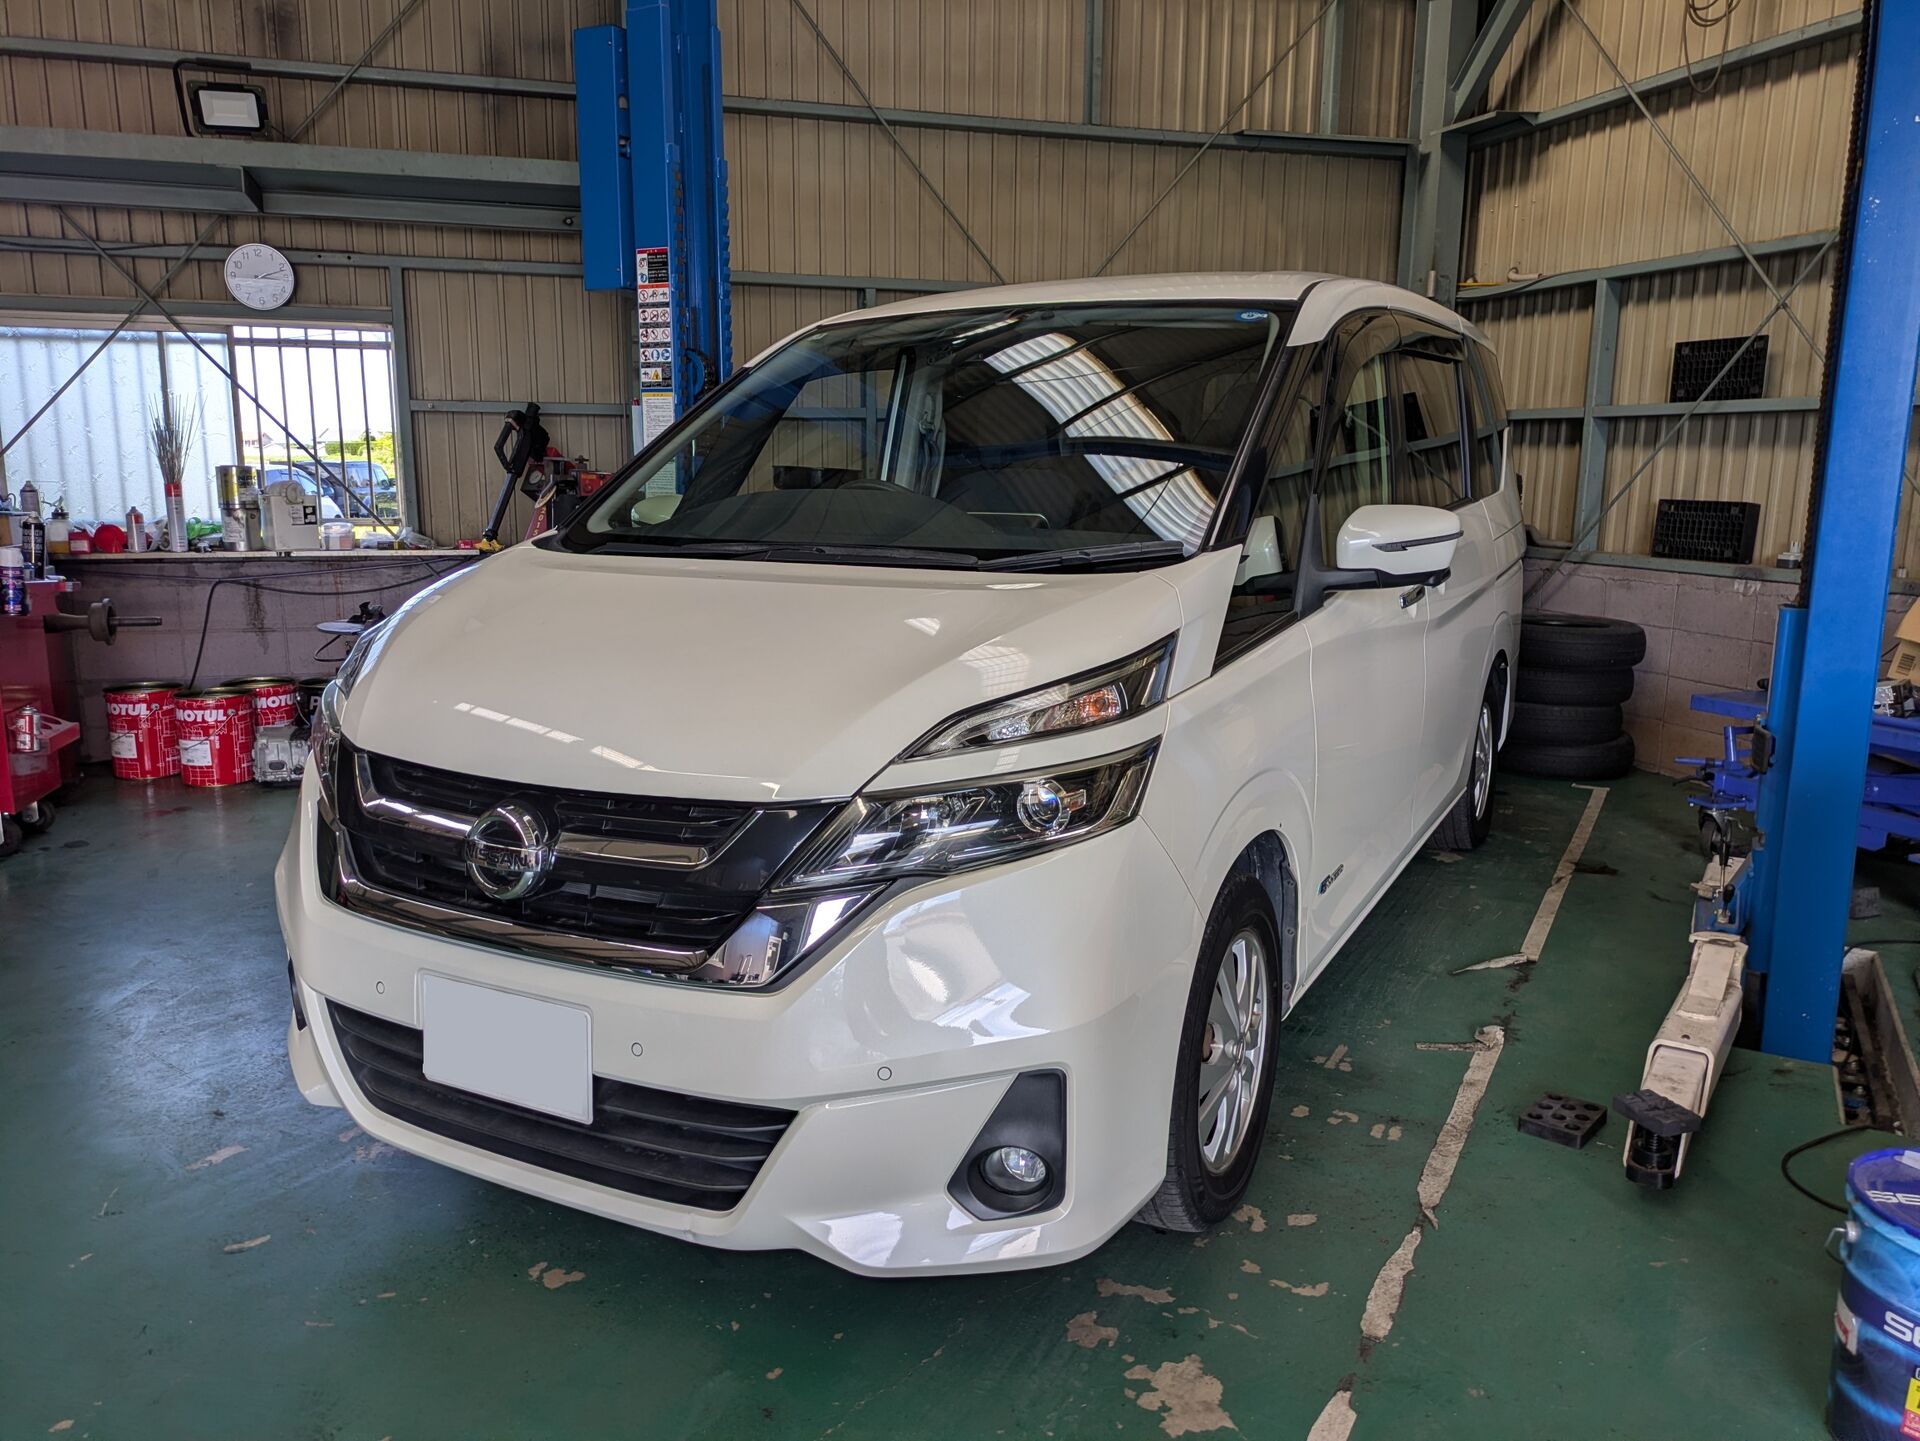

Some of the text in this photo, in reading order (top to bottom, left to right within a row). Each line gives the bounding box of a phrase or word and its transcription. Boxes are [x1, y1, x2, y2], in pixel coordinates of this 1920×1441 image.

[241, 251, 249, 260] 11
[253, 248, 262, 257] 12
[233, 260, 243, 269] 10
